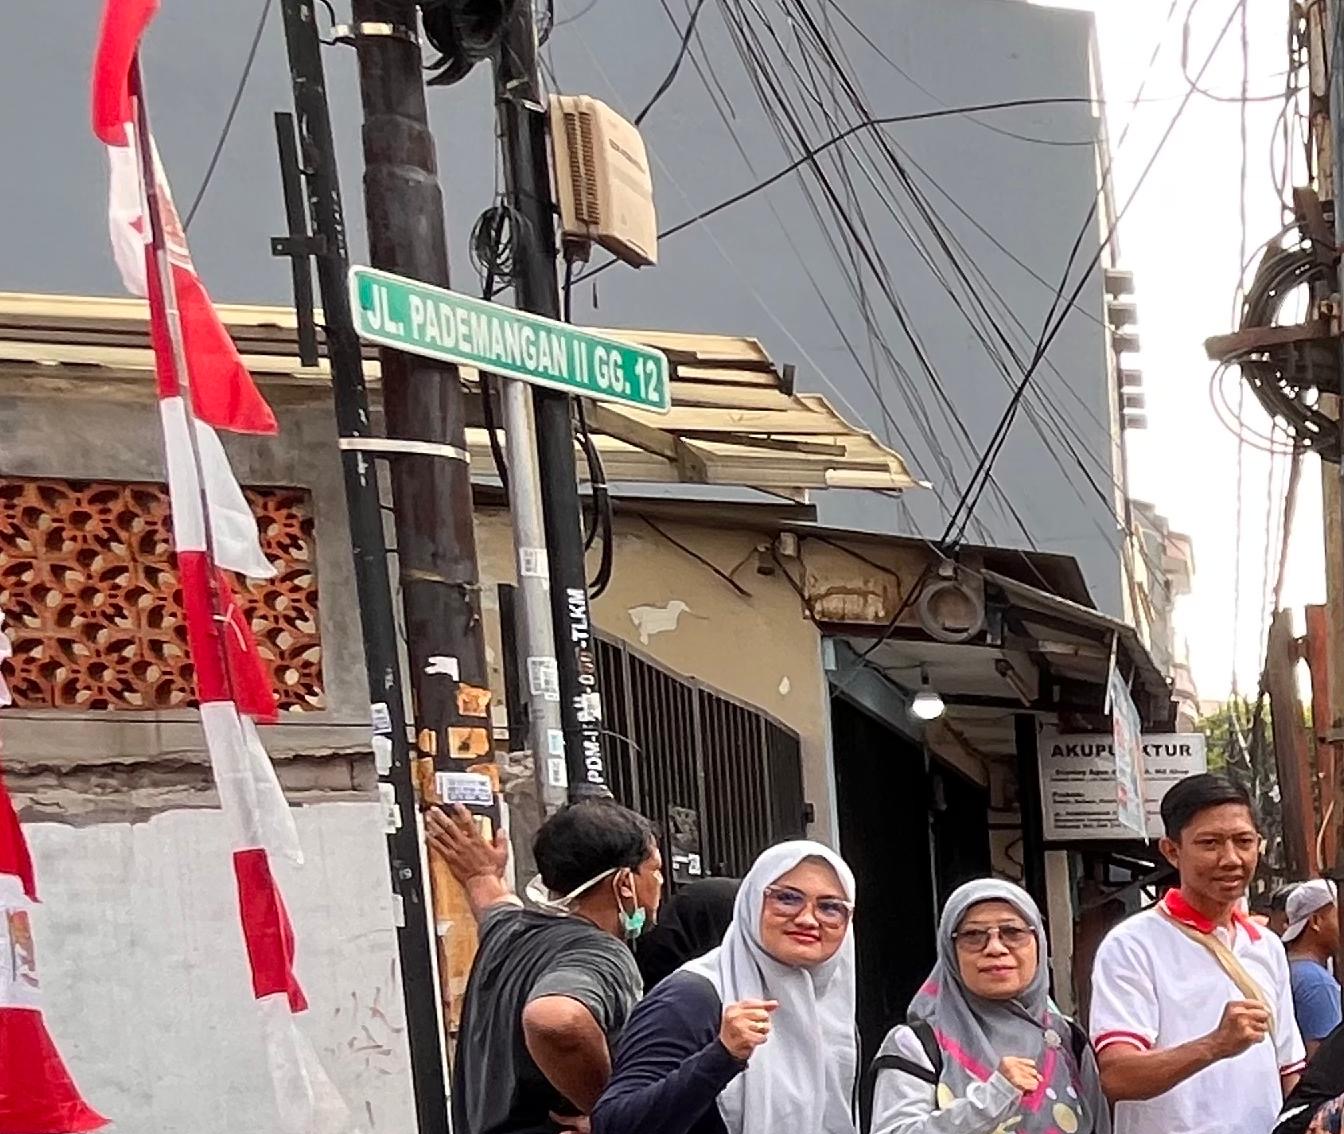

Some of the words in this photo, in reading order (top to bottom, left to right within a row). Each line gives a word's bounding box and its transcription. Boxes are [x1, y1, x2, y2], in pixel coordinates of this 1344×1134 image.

[366, 283, 404, 336] JL.
[408, 294, 569, 379] PADEMANGAN
[572, 339, 590, 384] II
[593, 345, 632, 396] GG.
[635, 357, 661, 402] 12
[1051, 743, 1192, 758] AKUPKTUR
